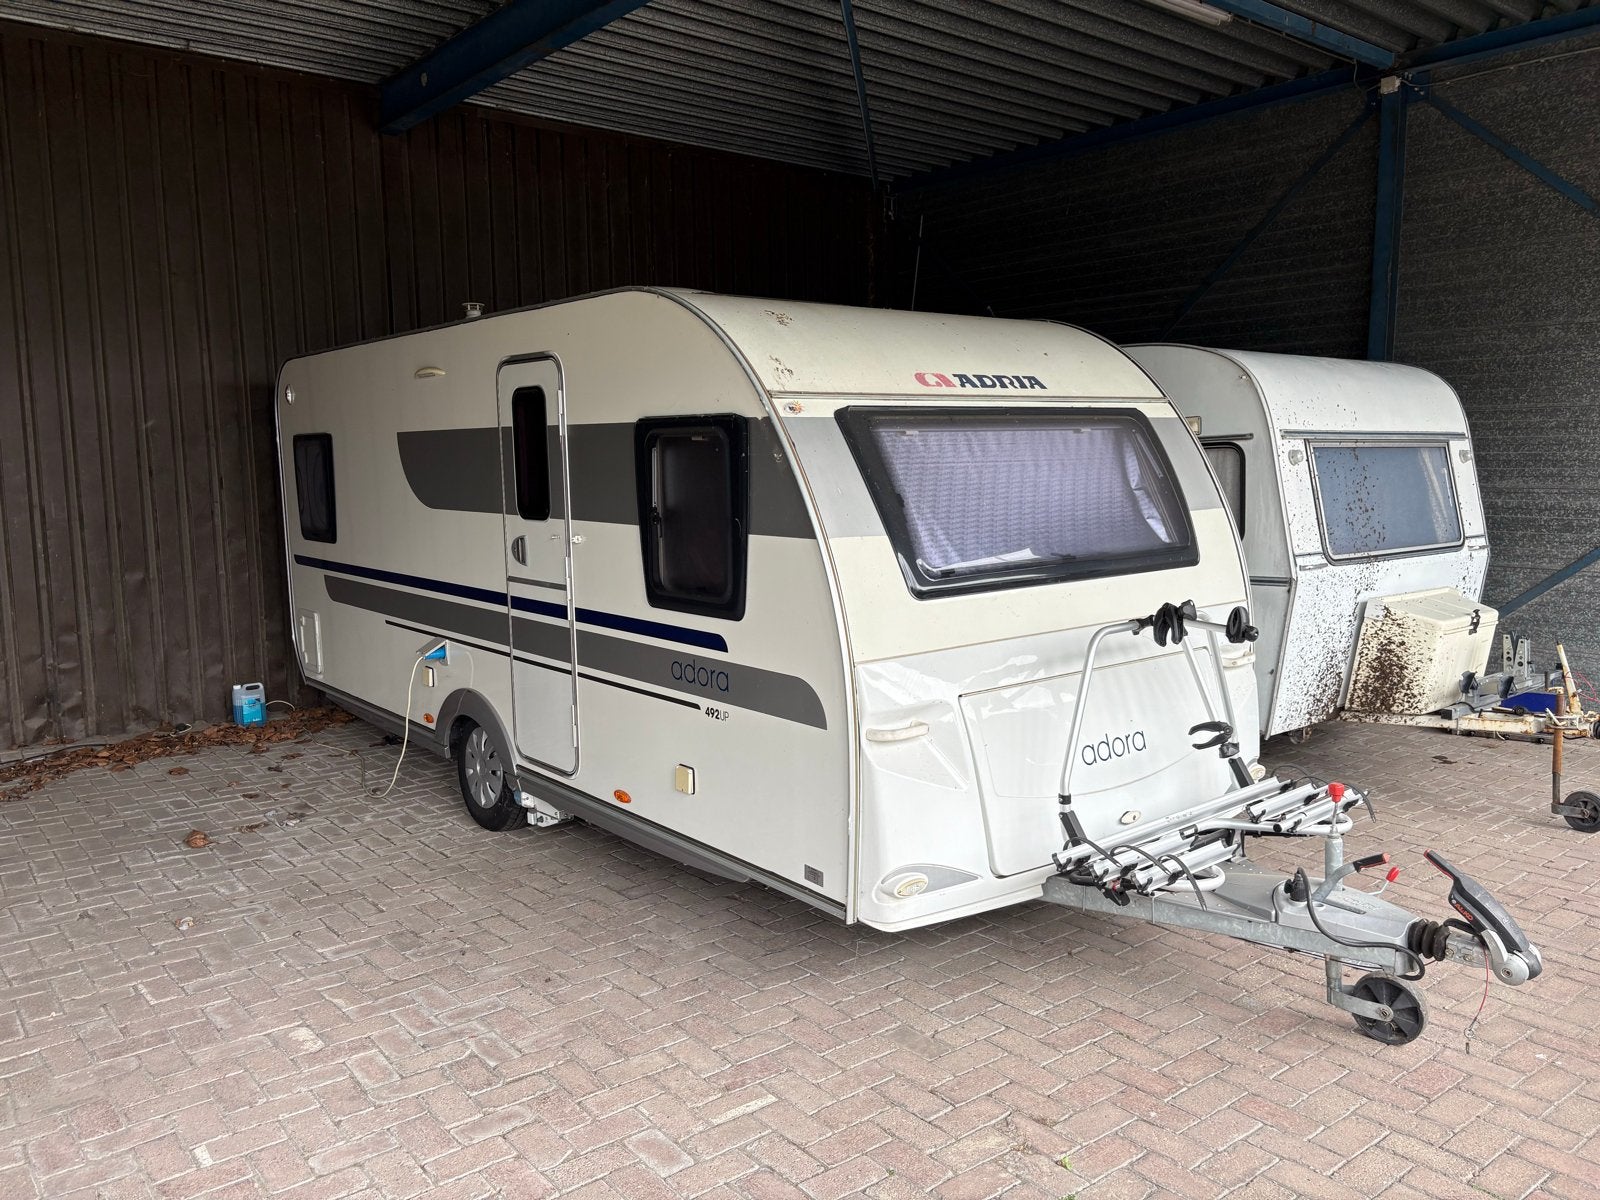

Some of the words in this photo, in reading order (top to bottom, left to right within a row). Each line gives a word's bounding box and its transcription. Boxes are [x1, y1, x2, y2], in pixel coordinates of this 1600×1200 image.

[951, 373, 1048, 390] ADRIA
[671, 659, 729, 692] adora
[704, 706, 730, 721] 492UP
[1081, 730, 1147, 766] adora
